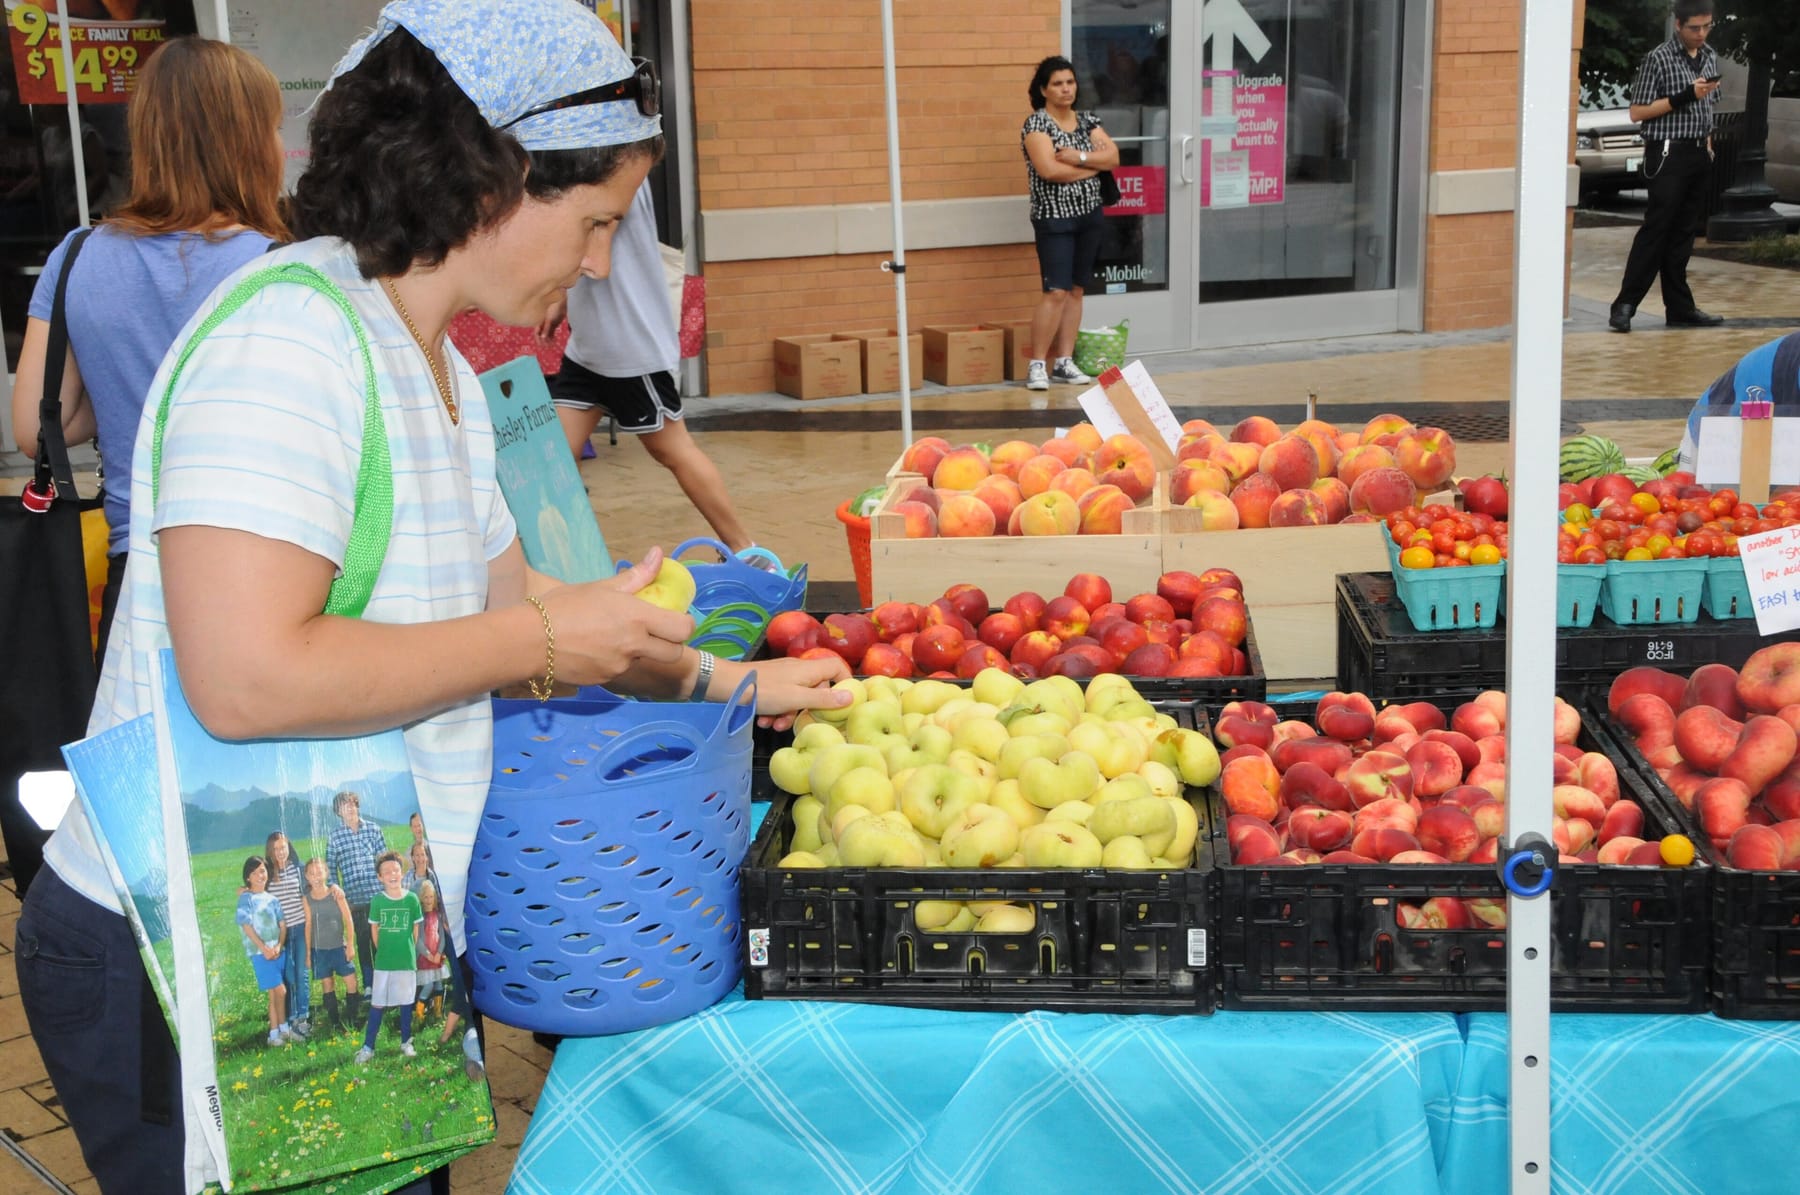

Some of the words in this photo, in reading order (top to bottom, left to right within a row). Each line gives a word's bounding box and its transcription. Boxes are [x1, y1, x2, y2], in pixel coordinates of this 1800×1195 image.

[12, 4, 48, 46] 9
[48, 27, 86, 41] PICE
[88, 28, 129, 42] FAMILY
[132, 28, 165, 41] MEAL
[1236, 73, 1283, 91] Upgrade
[1236, 91, 1265, 105] when
[1235, 108, 1256, 121] you
[1236, 117, 1279, 134] actually
[1235, 135, 1262, 147] want
[1263, 133, 1278, 146] to.
[1117, 176, 1144, 193] LTE
[493, 416, 528, 452] hesley
[522, 401, 557, 431] Farms
[1747, 536, 1783, 553] another
[1758, 590, 1787, 610] EASY
[1647, 650, 1674, 660] IFCO
